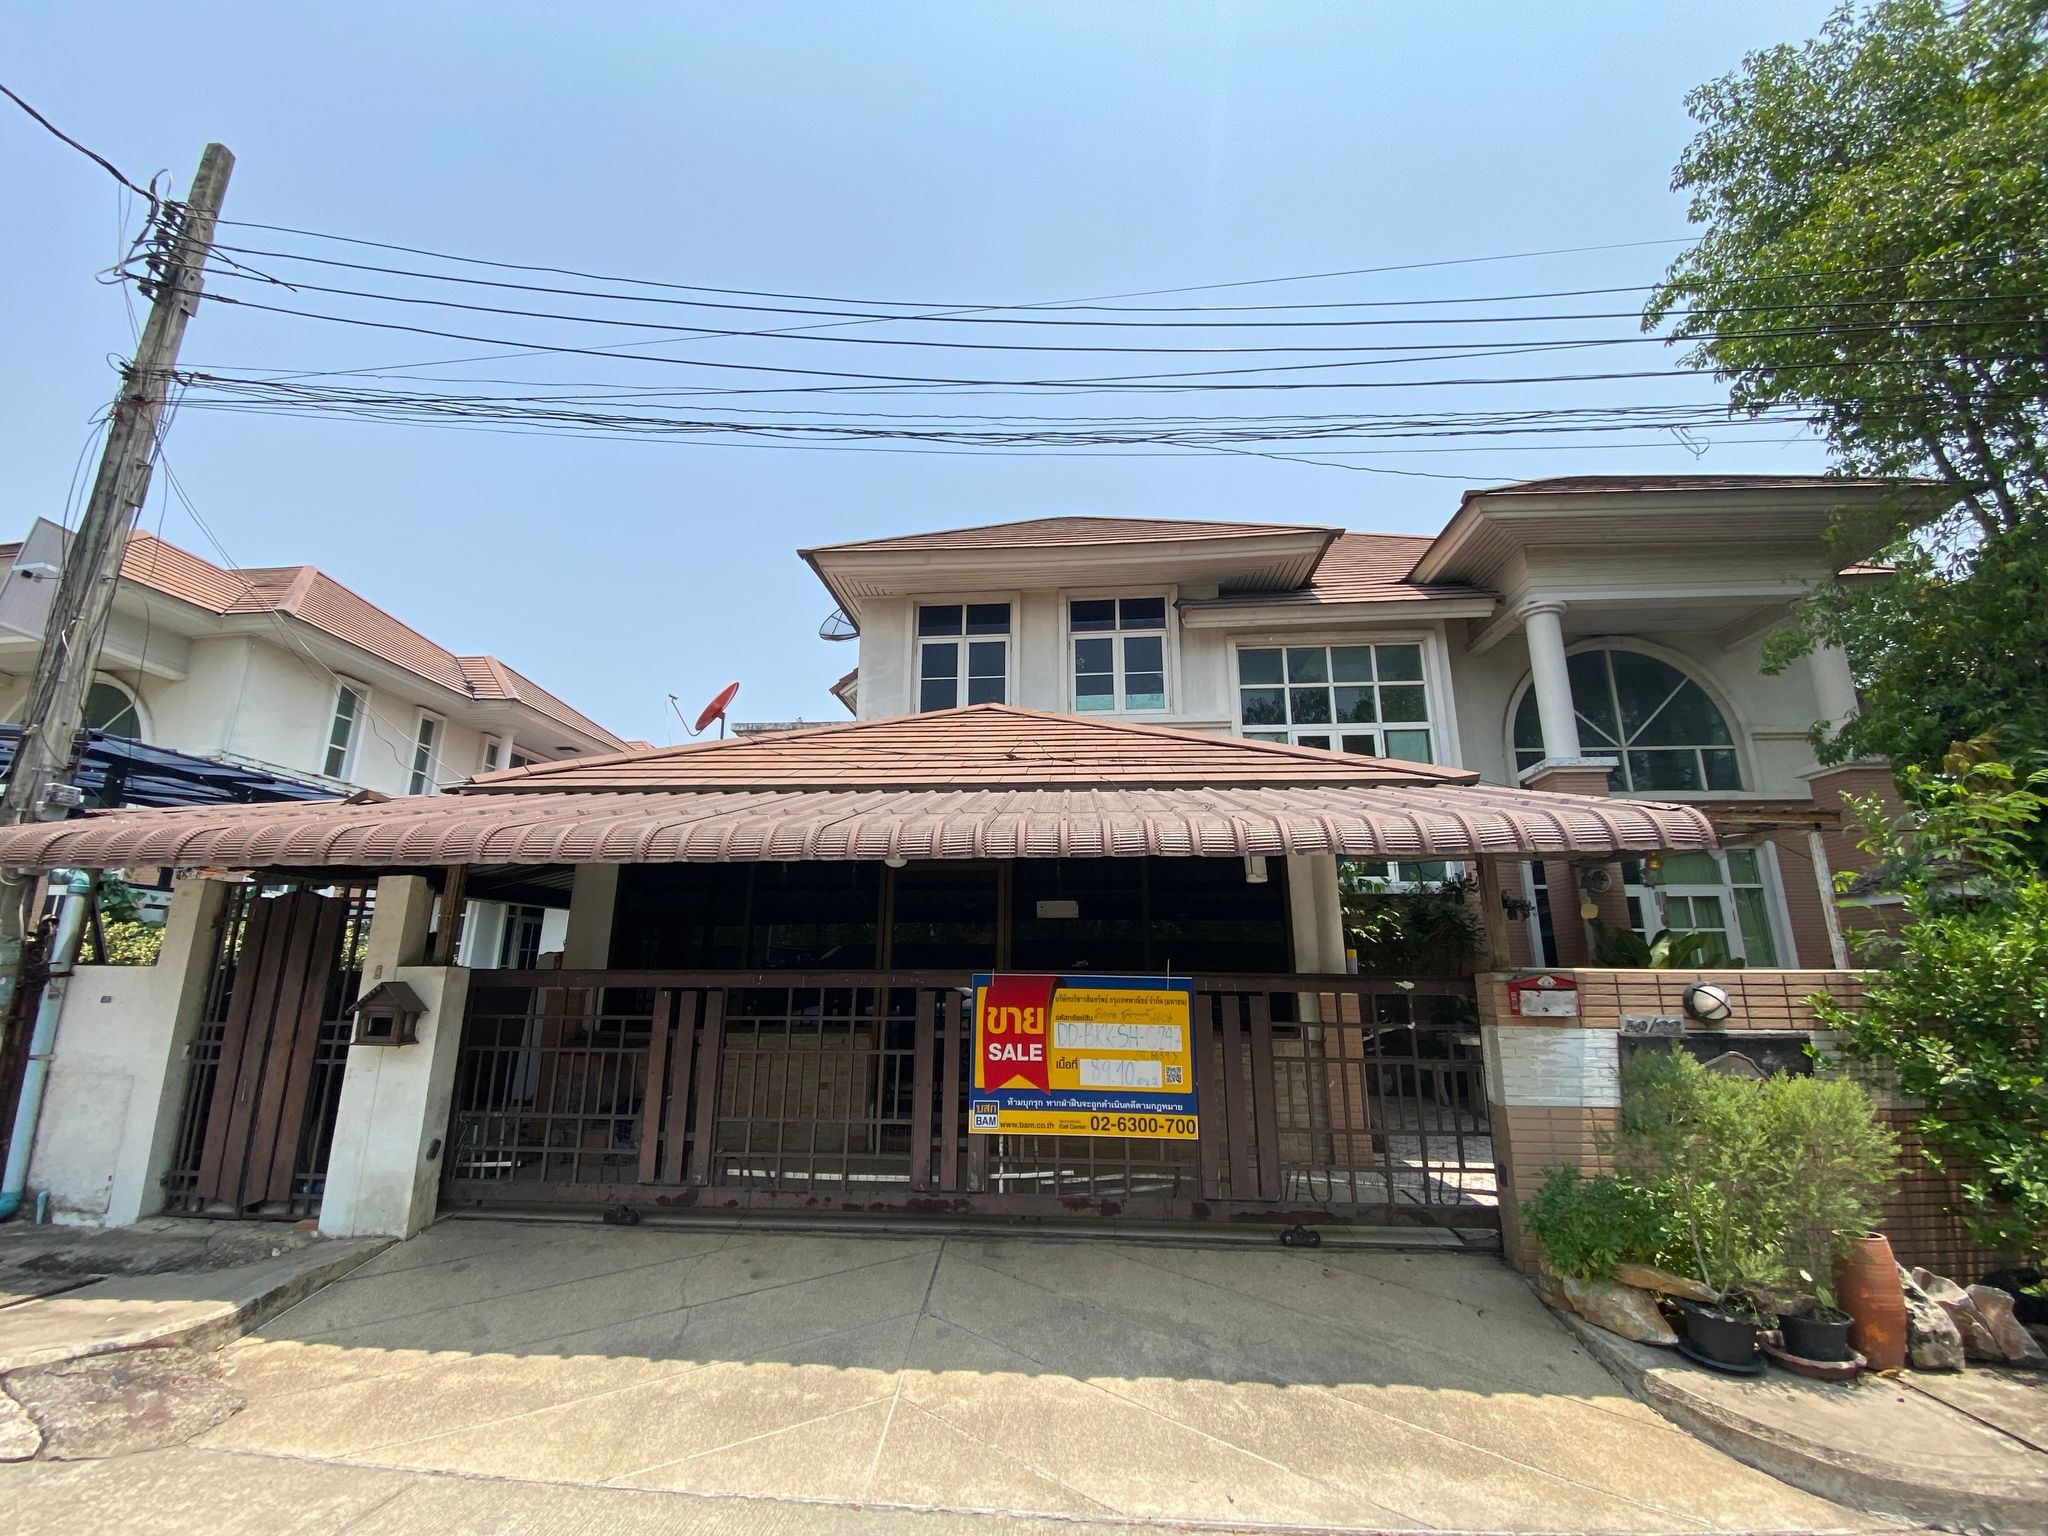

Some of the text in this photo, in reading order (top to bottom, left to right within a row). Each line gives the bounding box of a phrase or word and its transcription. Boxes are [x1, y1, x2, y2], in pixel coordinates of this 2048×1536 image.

[987, 1006, 1045, 1035] ขาย
[988, 1043, 1043, 1062] SALE
[1055, 1056, 1078, 1070] เนื้อที่
[976, 1104, 997, 1114] บสก
[1006, 1097, 1183, 1112] ห้ามบุกรุก หากฝ่าฝืนจะถูกดำเนินคดีตามกฎหมาย
[975, 1116, 997, 1127] BAM
[1000, 1121, 1054, 1130] www.bam.co.th
[1090, 1116, 1196, 1135] 02-6300-700
